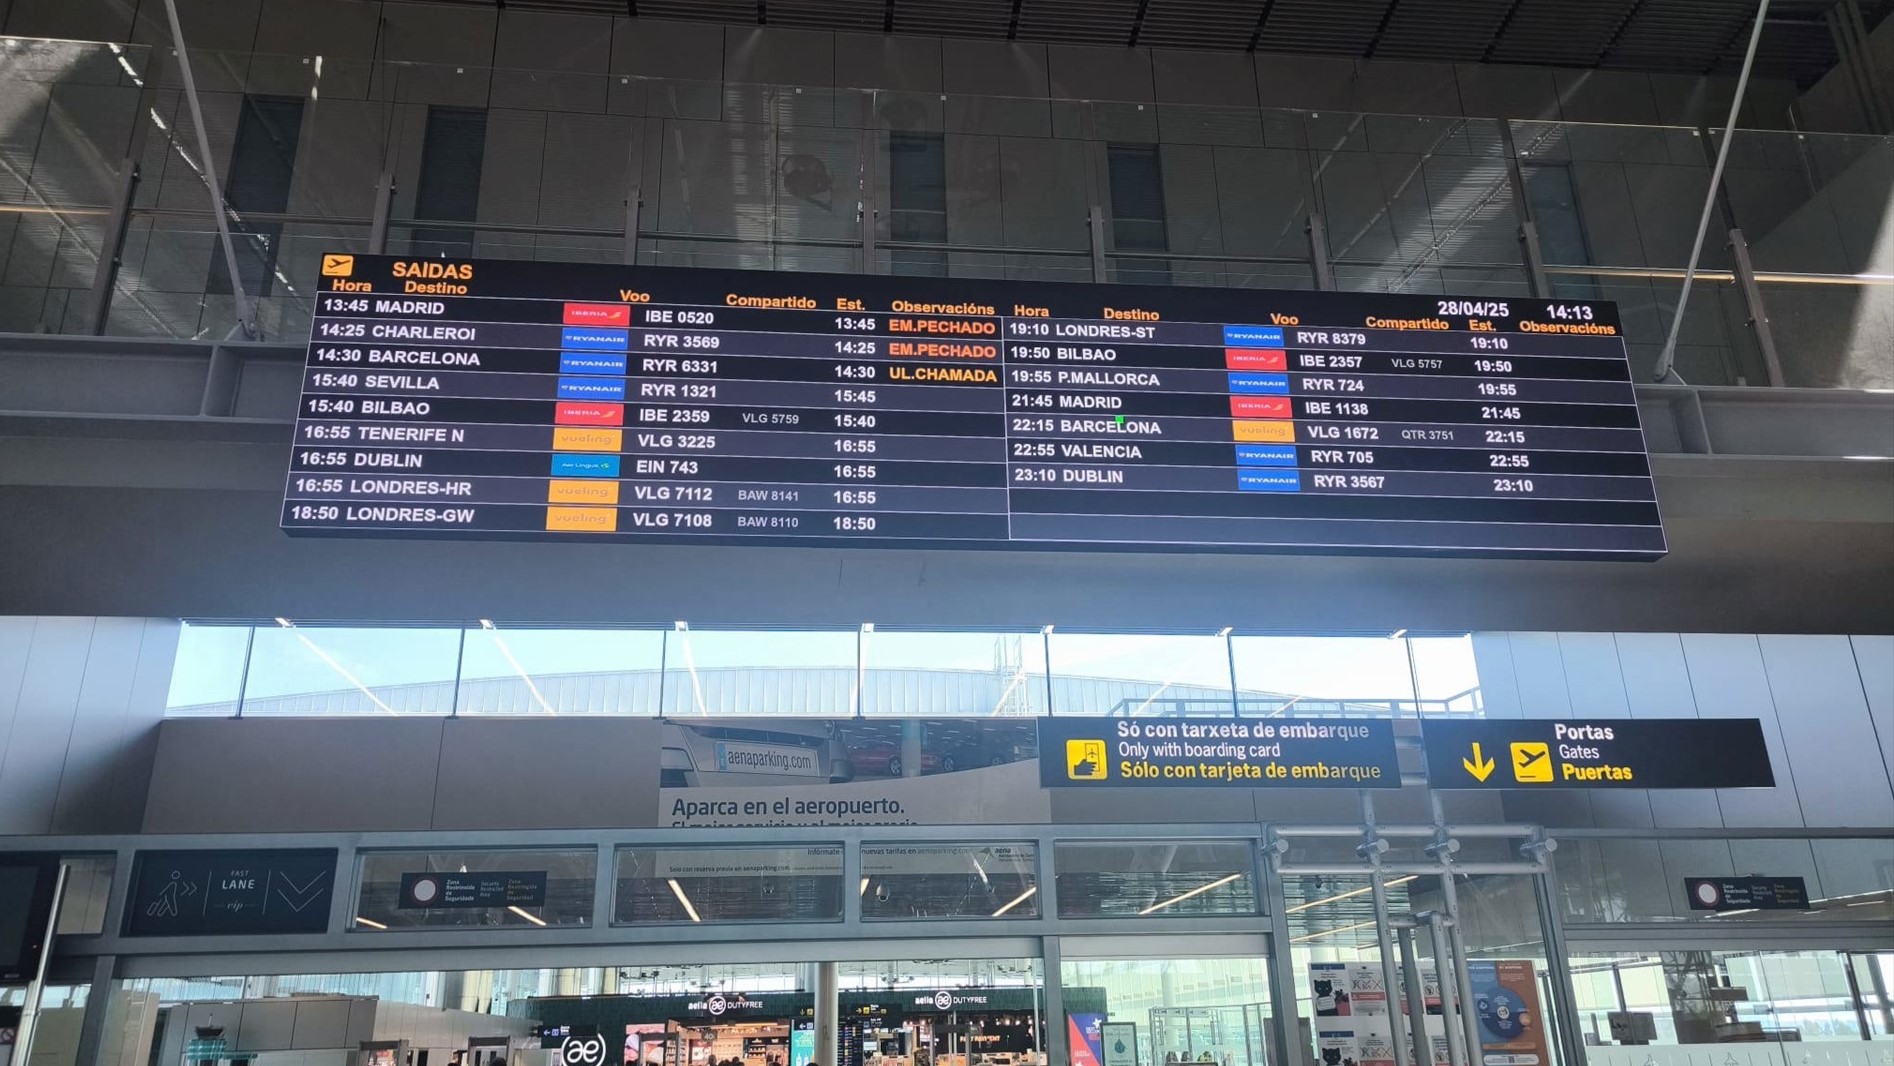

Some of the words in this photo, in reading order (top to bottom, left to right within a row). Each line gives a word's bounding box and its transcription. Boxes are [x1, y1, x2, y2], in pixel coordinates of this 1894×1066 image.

[332, 279, 372, 292] Hora
[405, 282, 468, 295] Destino
[620, 290, 650, 302] Voo
[727, 294, 816, 309] Compartido
[837, 298, 865, 310] Est.
[892, 301, 994, 315] Observacións
[325, 299, 368, 312] 13:45
[375, 300, 444, 314] MADRID
[646, 310, 673, 323] IBE
[678, 311, 714, 324] 0520
[835, 317, 875, 330] 13:45
[889, 319, 995, 334] EM.PECHADO
[1015, 305, 1049, 317] Hora
[1104, 308, 1159, 321] Destino
[1270, 313, 1299, 325] Voo
[1366, 316, 1449, 330] Compartido
[1469, 319, 1496, 331] Est.
[1520, 321, 1616, 335] Observacións
[1438, 301, 1509, 317] 28/04/25
[1547, 305, 1593, 320] 14:13
[321, 323, 365, 336] 14:25
[372, 325, 475, 340] CHARLEROI
[573, 335, 625, 343] RYANAIR
[644, 334, 678, 347] RYR
[683, 336, 719, 348] 3569
[835, 341, 875, 354] 14:25
[889, 343, 996, 358] EM.PECHADO
[1010, 323, 1049, 335] 19:10
[1056, 324, 1155, 338] LONDRES-ST
[1297, 332, 1329, 344] RYR
[1332, 333, 1366, 345] 8379
[1470, 337, 1508, 349] 19:10
[317, 348, 361, 361] 14:30
[369, 350, 480, 365] BARCELONA
[571, 360, 623, 368] RYANAIR
[643, 359, 677, 372] RYR
[682, 360, 717, 373] 6331
[835, 365, 875, 378] 14:30
[890, 367, 997, 382] UL.CHAMADA
[1011, 346, 1050, 359] 19:50
[1057, 348, 1116, 361] BILBAO
[1300, 355, 1326, 367] IBE
[1329, 356, 1362, 368] 2357
[1391, 359, 1415, 368] VLG
[1418, 359, 1442, 369] 5757
[1474, 360, 1512, 372] 19:50
[313, 374, 358, 387] 15:40
[365, 375, 439, 389] SEVILLA
[569, 385, 622, 393] RYANAIR
[641, 383, 676, 397] RYR
[681, 385, 716, 398] 1321
[835, 389, 876, 403] 15:45
[1012, 370, 1052, 383] 19:55
[1058, 371, 1160, 386] P.MALLORCA
[1303, 378, 1335, 390] RYR
[1338, 379, 1364, 391] 724
[1478, 383, 1517, 395] 19:55
[309, 399, 354, 413] 15:40
[362, 401, 430, 415] BILBAO
[640, 408, 668, 422] IBE
[672, 410, 710, 423] 2359
[742, 413, 768, 423] VLG
[771, 414, 799, 424] 5759
[834, 414, 875, 427] 15:40
[1012, 394, 1053, 407] 21:45
[1060, 395, 1122, 408] MADRID
[1305, 402, 1331, 414] IBE
[1335, 403, 1368, 415] 1138
[1482, 407, 1521, 419] 21:45
[305, 425, 350, 439] 16:55
[358, 427, 447, 441] TENERIFE
[452, 429, 464, 442] N
[638, 434, 673, 447] VLG
[678, 435, 715, 448] 3225
[834, 439, 876, 453] 16:55
[1013, 419, 1054, 431] 22:15
[1061, 420, 1162, 434] BARCELONA
[1307, 426, 1340, 438] VLG
[1344, 427, 1379, 439] 1672
[1401, 430, 1427, 439] QTR
[1429, 430, 1454, 440] 3751
[1485, 430, 1525, 443] 22:15
[301, 452, 347, 465] 16:55
[354, 453, 422, 467] DUBLIN
[637, 460, 664, 473] EIN
[670, 461, 698, 474] 743
[834, 465, 876, 478] 16:55
[1014, 443, 1055, 456] 22:55
[1061, 444, 1142, 458] VALENCIA
[1311, 450, 1344, 463] RYR
[1347, 451, 1374, 463] 705
[1490, 455, 1529, 467] 22:55
[296, 479, 343, 492] 16:55
[350, 480, 471, 495] LONDRES-HR
[635, 486, 670, 499] VLG
[675, 487, 712, 500] 7112
[738, 490, 768, 500] BAW
[771, 491, 798, 501] 8141
[834, 491, 876, 504] 16:55
[1015, 468, 1056, 481] 23:10
[1063, 469, 1123, 483] DUBLIN
[1314, 475, 1347, 488] RYR
[1351, 476, 1385, 488] 3567
[1493, 479, 1533, 492] 23:10
[292, 506, 338, 520] 18:50
[347, 507, 475, 523] LONDRES-GW
[633, 513, 669, 526] VLG
[674, 513, 712, 527] 7108
[738, 516, 768, 527] BAW
[771, 517, 798, 527] 8110
[834, 517, 876, 530] 18:50
[1118, 721, 1140, 737] Só
[1145, 725, 1177, 737] con
[1181, 723, 1249, 738] tarxeta
[1253, 721, 1275, 738] de
[1279, 722, 1369, 741] embarque
[1554, 724, 1614, 740] Portas
[728, 750, 812, 771] aenaparking.com
[1119, 741, 1149, 760] Only
[1152, 742, 1182, 757] with
[1184, 742, 1246, 760] boarding
[1249, 742, 1281, 757] card
[1559, 744, 1600, 759] Gates
[1121, 761, 1159, 778] Sólo
[1164, 766, 1196, 778] con
[1199, 761, 1261, 781] tarjeta
[1266, 762, 1287, 778] de
[1291, 762, 1380, 781] embarque
[1562, 763, 1632, 780] Puertas
[672, 798, 737, 819] Aparca
[744, 802, 767, 814] en
[773, 797, 789, 814] el
[795, 800, 904, 817] aeropuerto.
[222, 879, 255, 890] LANE
[727, 1001, 763, 1009] DUTYFREE
[953, 996, 987, 1004] DUTYFREE
